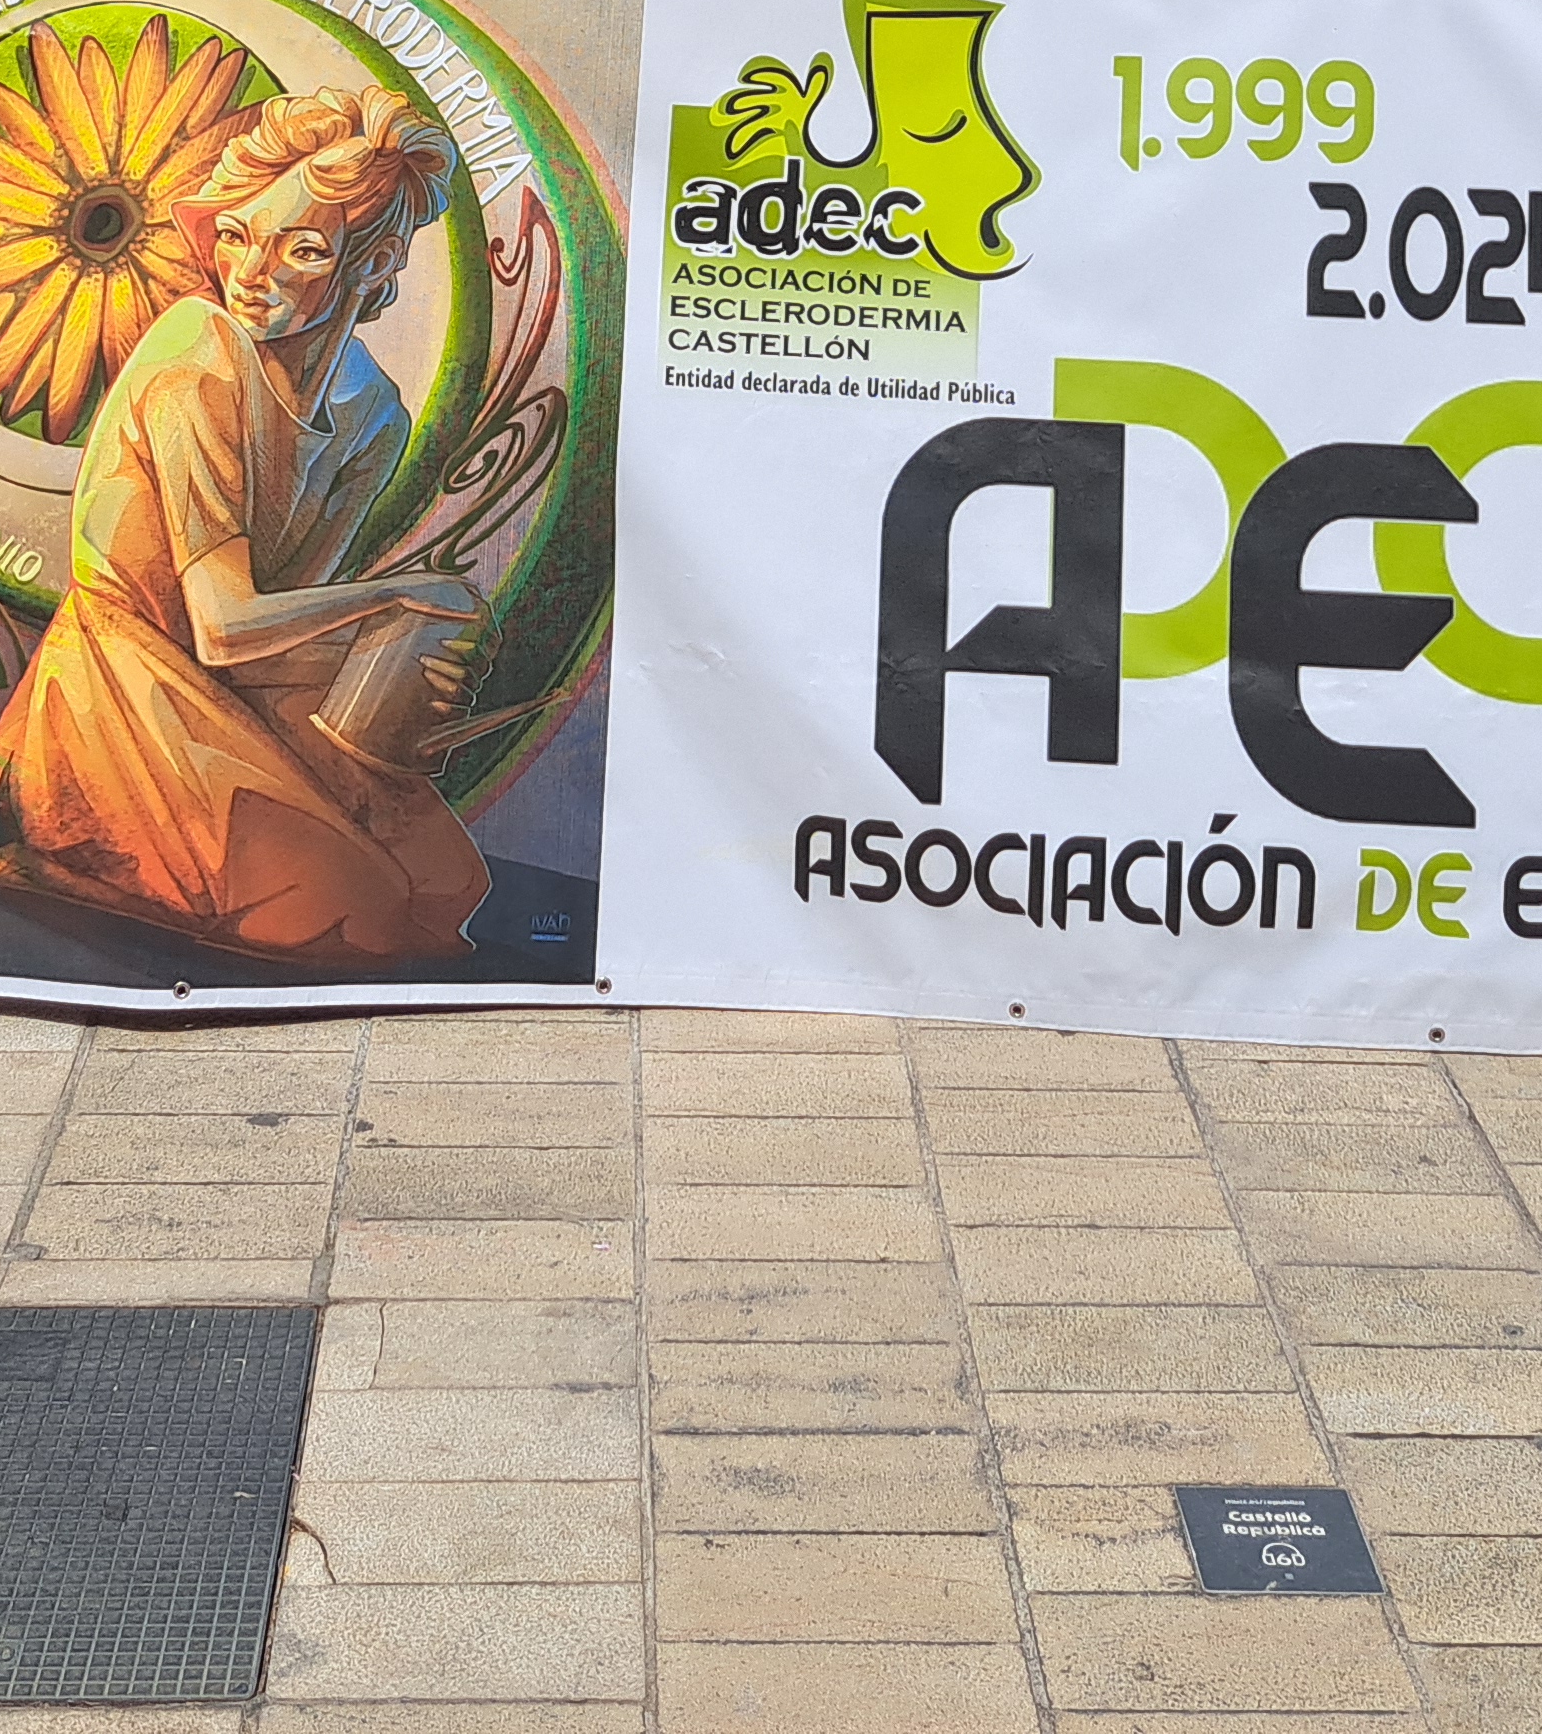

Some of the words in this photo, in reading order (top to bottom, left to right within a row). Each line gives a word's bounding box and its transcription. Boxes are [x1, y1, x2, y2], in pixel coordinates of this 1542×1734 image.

[1111, 55, 1376, 172] 1.999
[672, 158, 923, 260] adec
[671, 262, 883, 296] ASOCIACIÓN
[892, 278, 932, 299] DE
[669, 295, 968, 334] ESCLERODERMIA
[667, 328, 871, 362] CASTELLÓN
[664, 365, 736, 391] Entidad
[741, 371, 832, 396] declarada
[838, 375, 861, 398] de
[867, 377, 941, 402] Utilidad
[947, 380, 1017, 406] Pública
[794, 812, 1318, 937] ASOCIACIÓN
[1354, 845, 1475, 939] DE
[1228, 1510, 1313, 1523] Castelló
